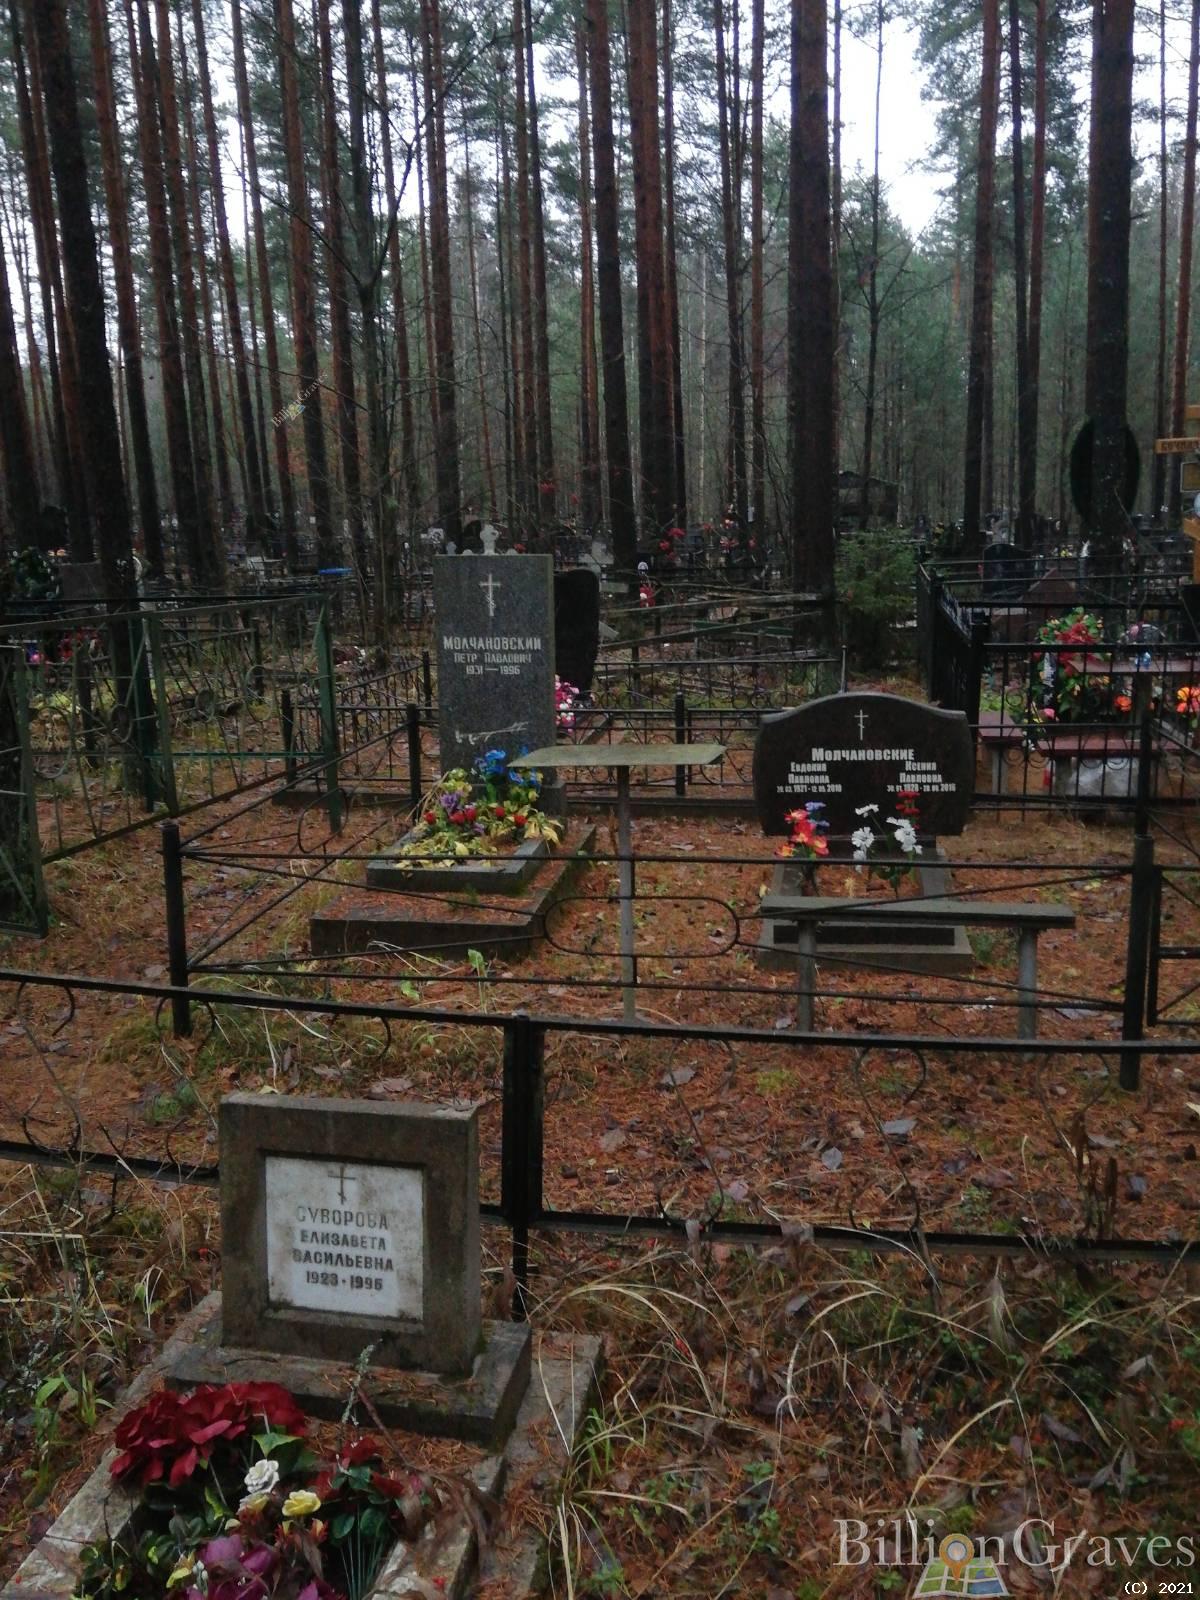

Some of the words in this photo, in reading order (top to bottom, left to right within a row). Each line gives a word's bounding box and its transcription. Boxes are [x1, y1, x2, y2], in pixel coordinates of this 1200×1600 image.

[454, 653, 477, 663] ПЕТР
[296, 1206, 387, 1230] СУВОРОВА
[300, 1229, 386, 1251] ЕЛИЗАВЕТА
[291, 1248, 394, 1272] ВАСИЛЬЕВНА
